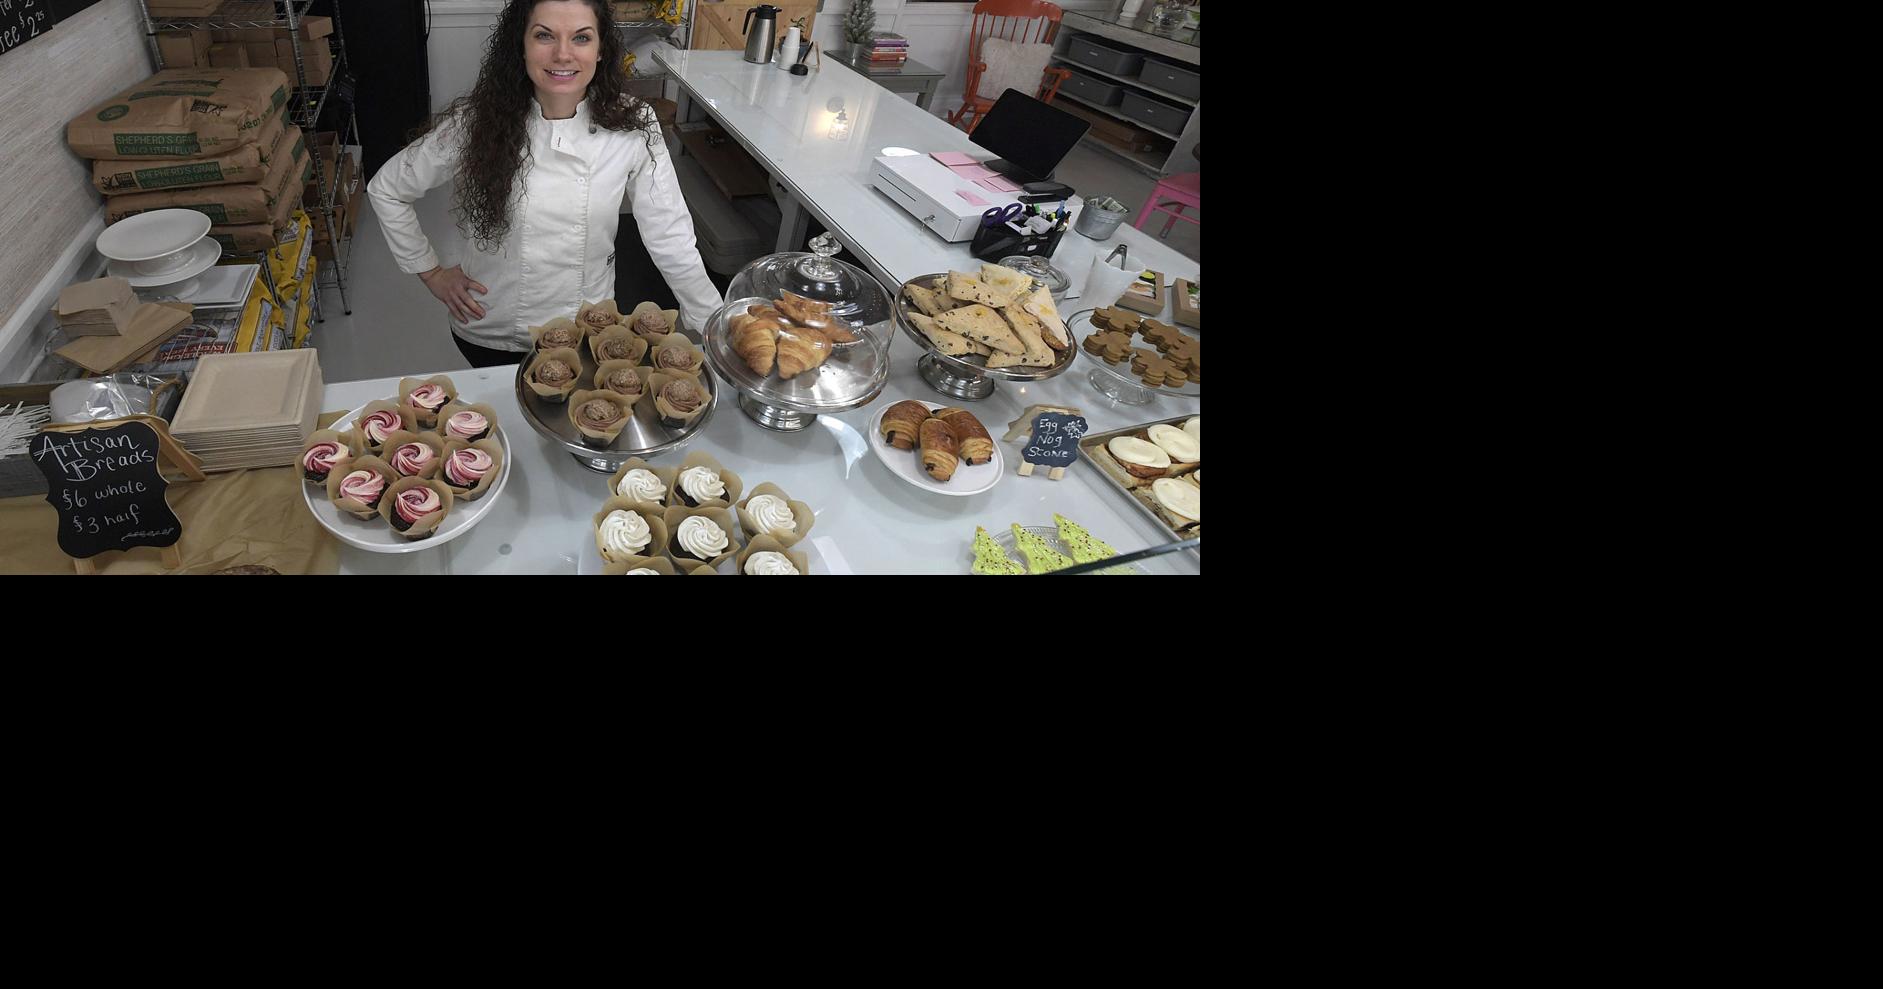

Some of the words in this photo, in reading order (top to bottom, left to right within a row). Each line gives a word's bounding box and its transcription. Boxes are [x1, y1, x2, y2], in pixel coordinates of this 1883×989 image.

[116, 135, 172, 144] SHEPHERD'S
[137, 166, 191, 179] SHEPHERD'S
[1039, 418, 1058, 435] Egg
[1036, 435, 1063, 448] Nog
[34, 435, 140, 473] Artisan
[65, 450, 155, 482] Breads
[63, 488, 87, 510] $6
[95, 480, 147, 500] whole
[104, 503, 141, 526] half
